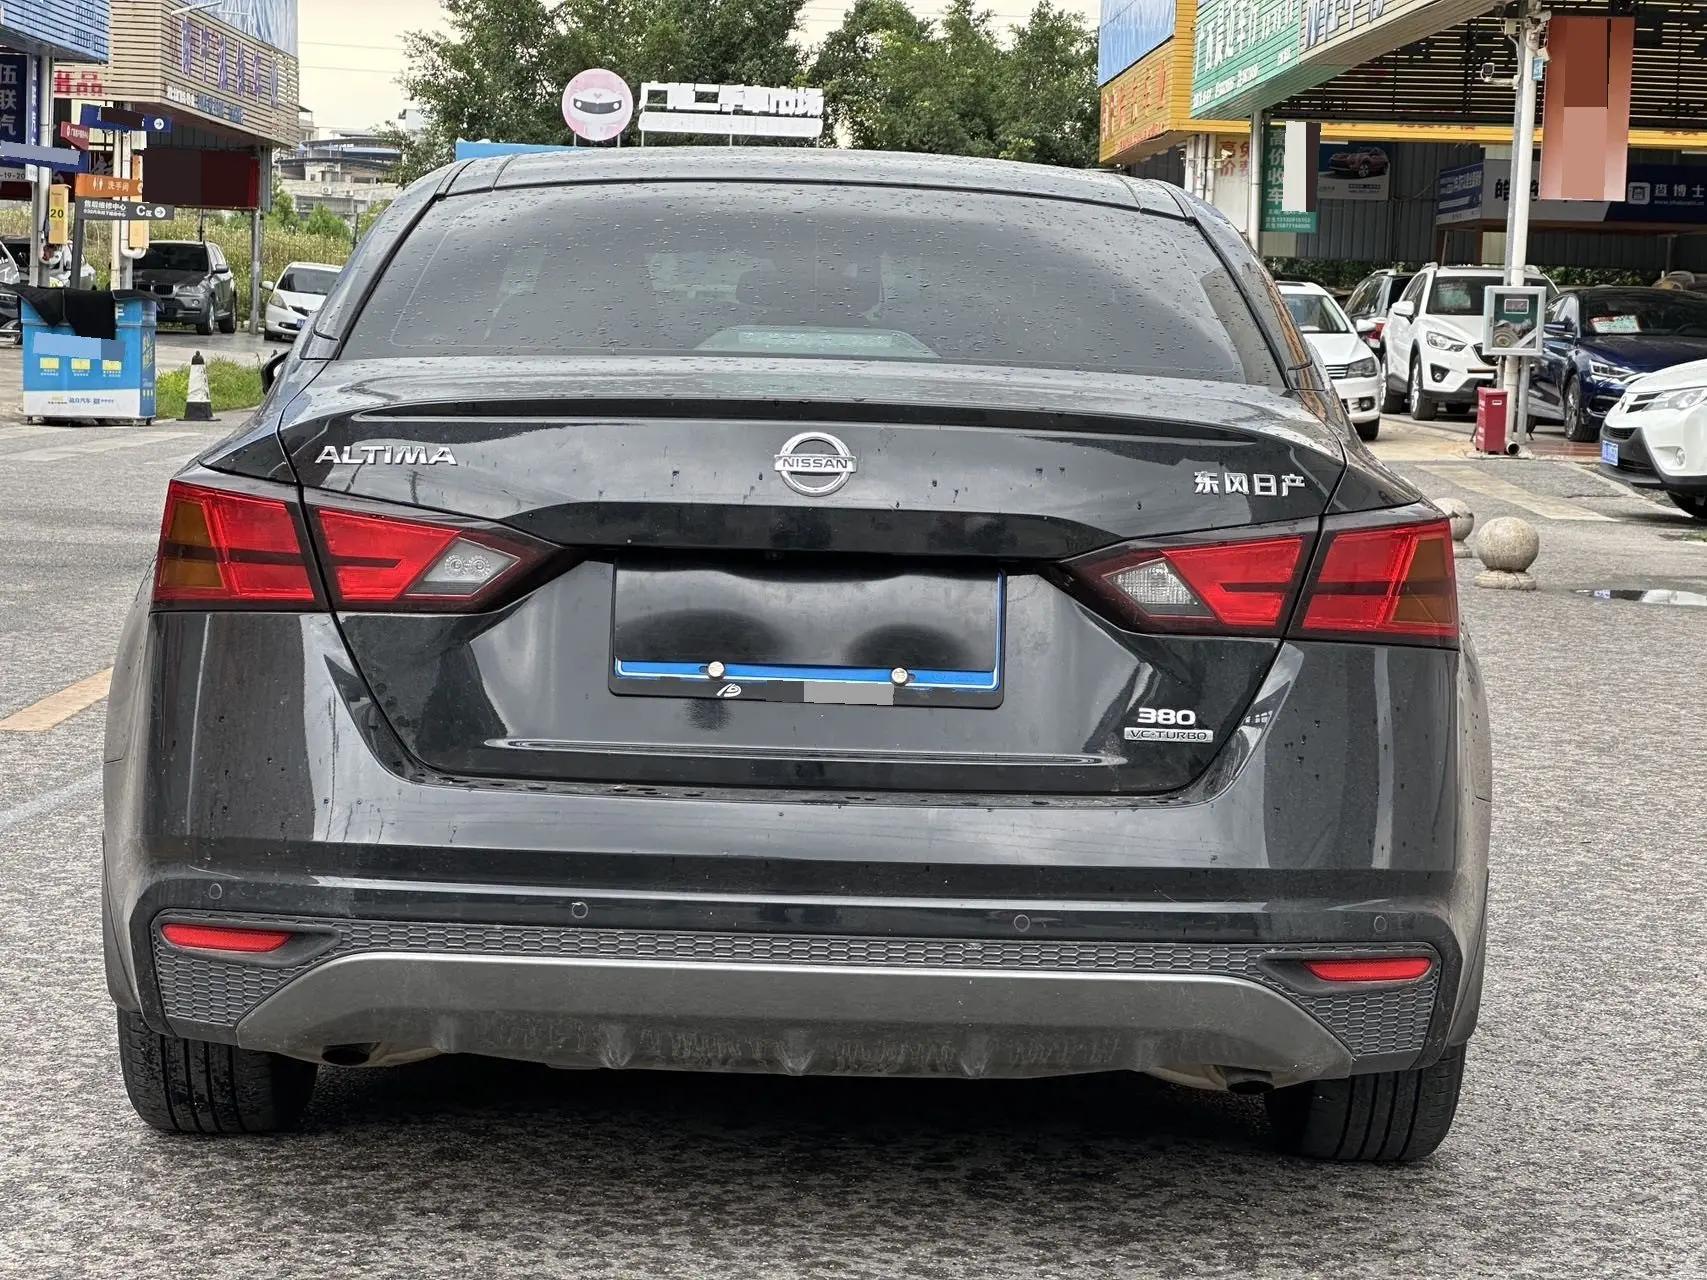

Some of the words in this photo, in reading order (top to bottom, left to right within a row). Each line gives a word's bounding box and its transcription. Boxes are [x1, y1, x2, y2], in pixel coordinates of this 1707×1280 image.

[50, 208, 65, 218] 20
[314, 445, 459, 465] ALTIMA
[782, 457, 849, 469] NISSAN
[1193, 470, 1306, 497] 东风日产
[1136, 707, 1197, 726] 380
